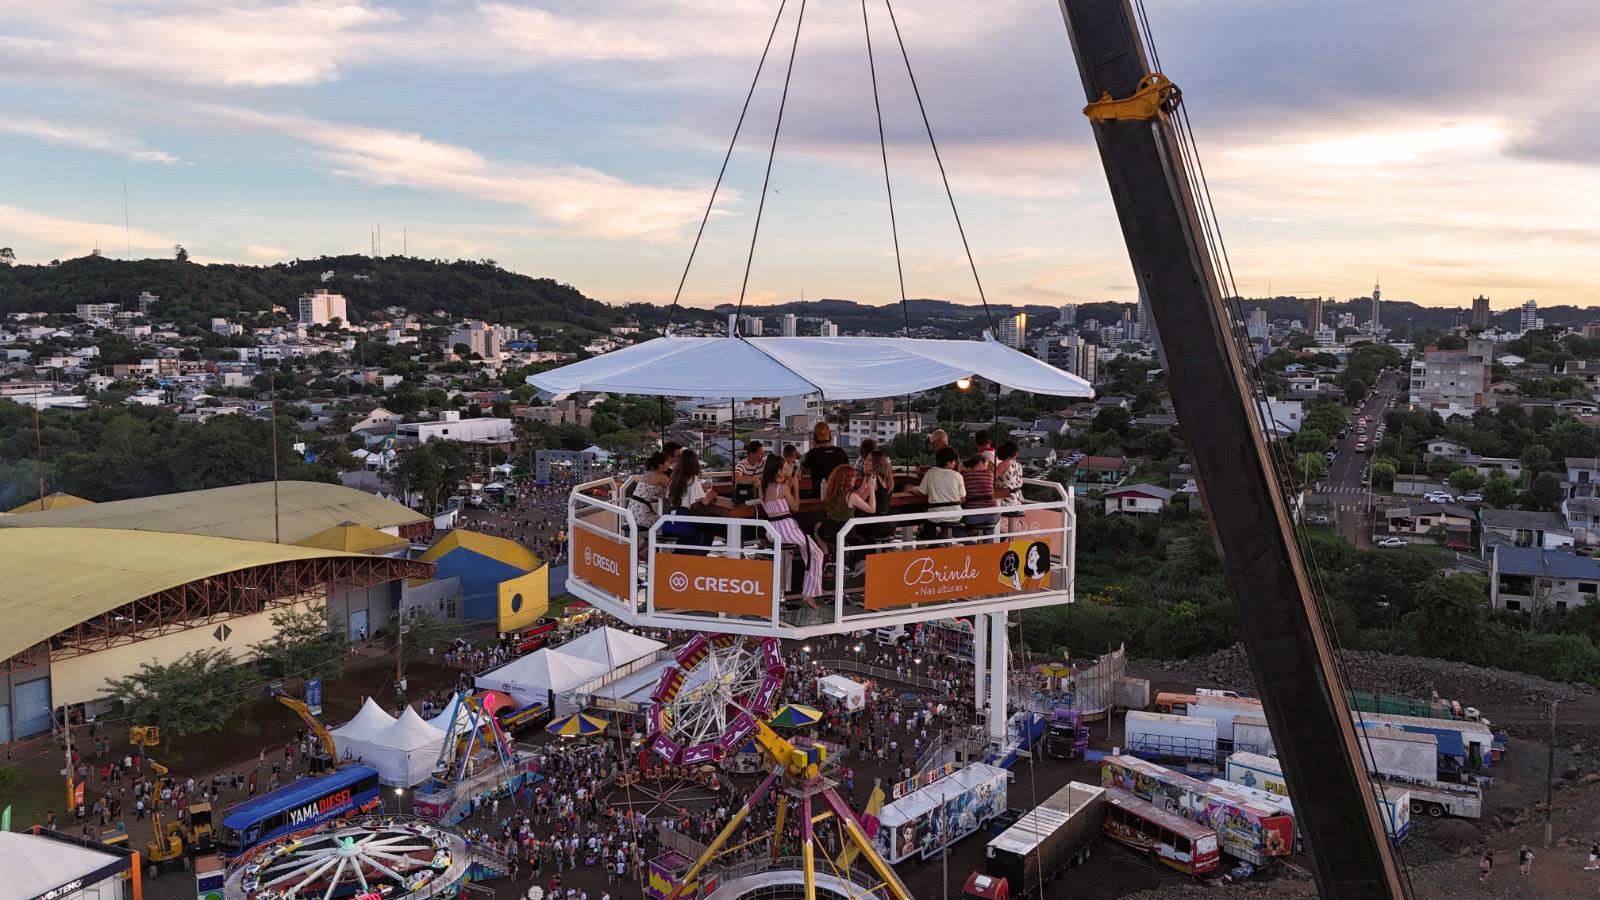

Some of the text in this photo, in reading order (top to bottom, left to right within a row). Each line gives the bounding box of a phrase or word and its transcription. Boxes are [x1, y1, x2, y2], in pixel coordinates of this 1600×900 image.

[593, 553, 620, 576] CRESOL
[904, 555, 979, 585] Brinde
[694, 576, 765, 596] CRESOL
[920, 584, 963, 596] Nas alturas
[314, 802, 354, 823] EQUIPAMENTOS
